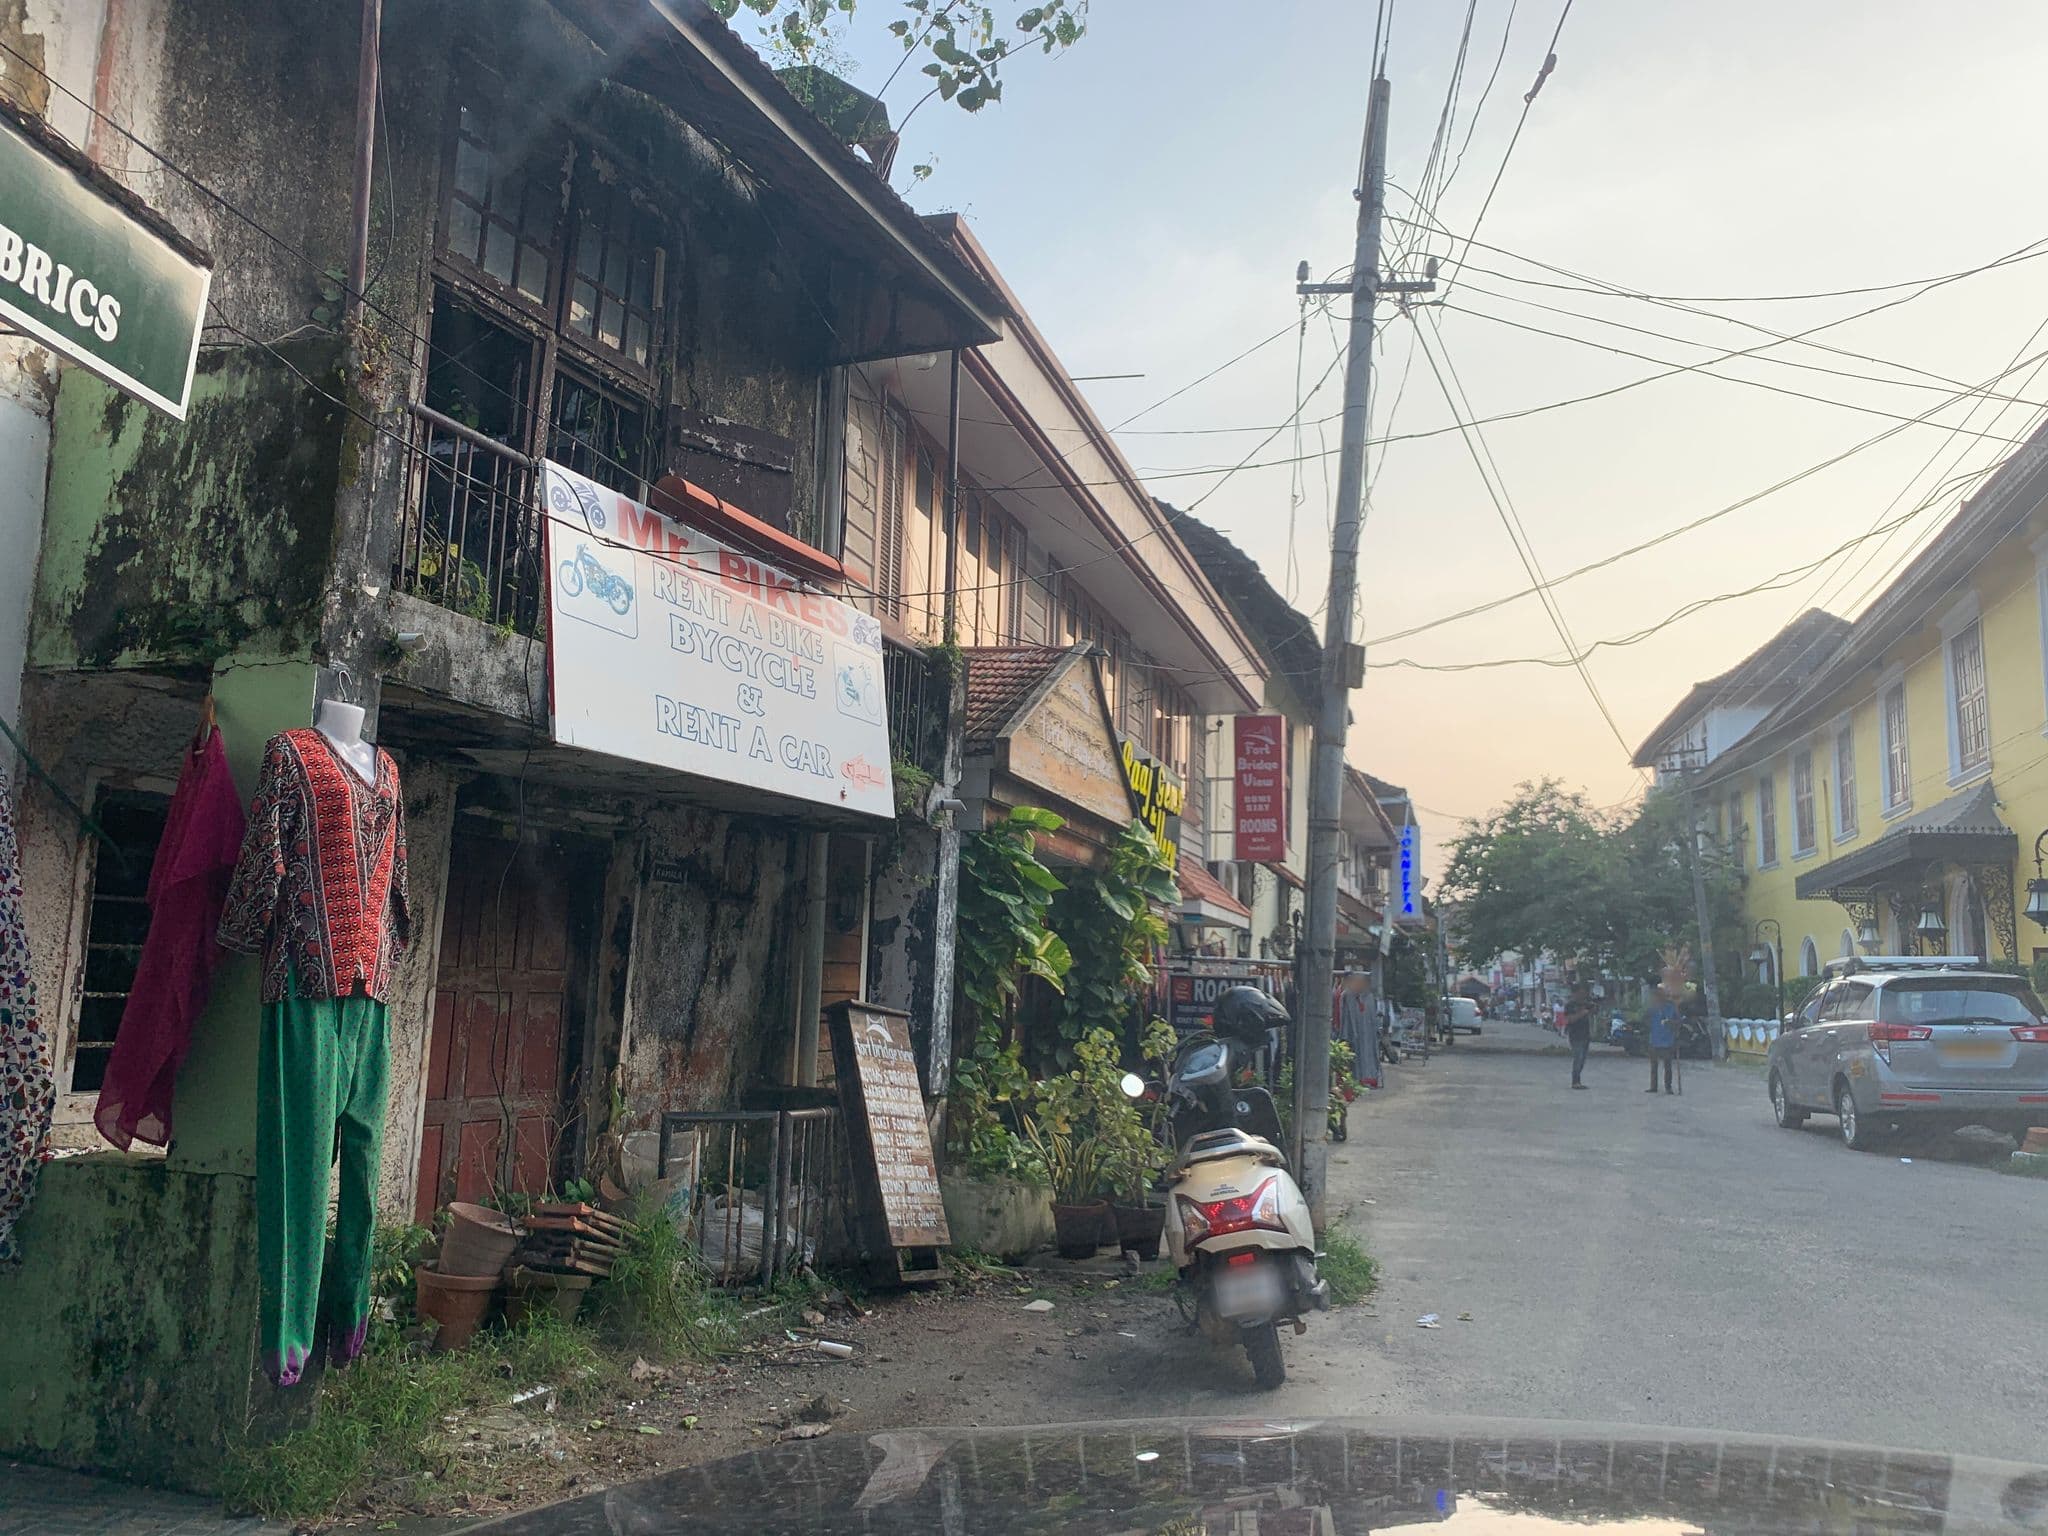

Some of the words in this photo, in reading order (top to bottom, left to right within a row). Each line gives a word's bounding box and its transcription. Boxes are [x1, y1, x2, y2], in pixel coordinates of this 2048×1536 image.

[0, 222, 121, 342] BRICS
[617, 499, 701, 567] Mr.
[719, 547, 850, 636] BIKES
[653, 559, 732, 626] RENT
[740, 605, 763, 640] A
[769, 612, 825, 665] BIKE
[669, 613, 817, 700] BYCYCLE
[655, 694, 741, 753] RENT
[749, 726, 774, 763] A
[779, 735, 834, 779] CAR
[736, 683, 765, 718] &
[1238, 757, 1279, 771] Bridge
[1244, 741, 1271, 755] Fort
[1240, 818, 1278, 833] ROOMS
